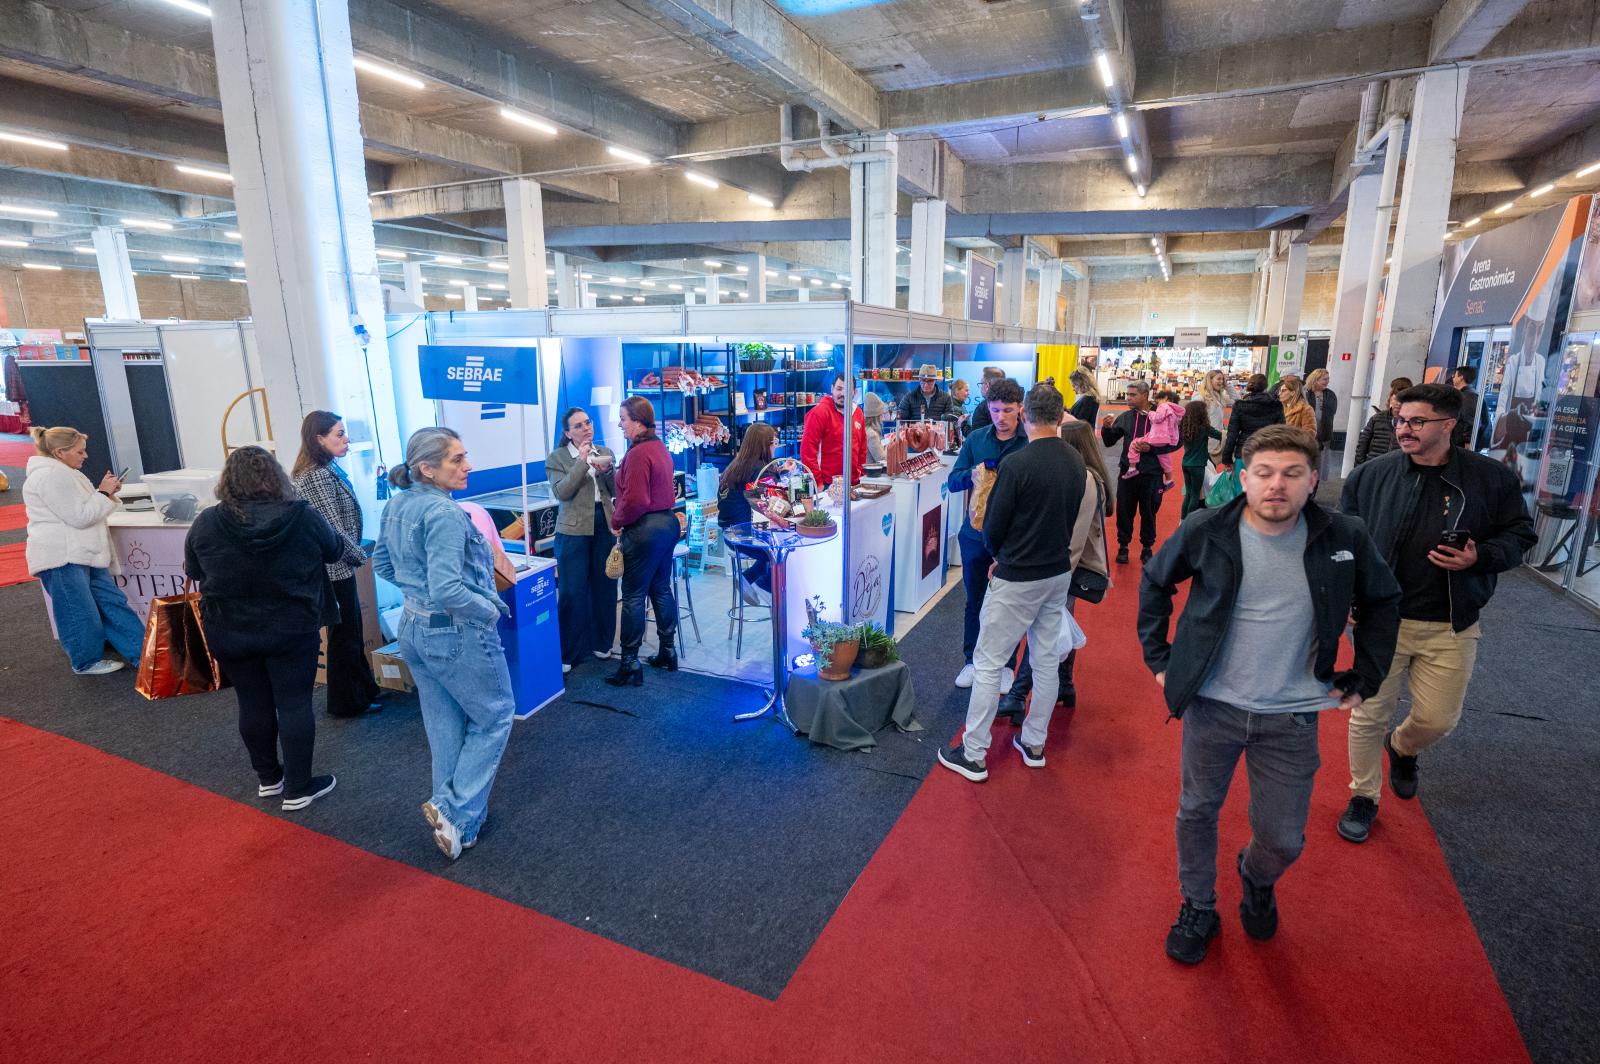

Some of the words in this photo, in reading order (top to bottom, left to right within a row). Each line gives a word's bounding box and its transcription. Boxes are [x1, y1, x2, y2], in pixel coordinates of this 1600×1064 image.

[1471, 259, 1491, 274] Arena
[1465, 299, 1487, 315] Senac
[447, 366, 503, 382] SEBRAE
[1562, 406, 1579, 415] ESSA
[530, 579, 550, 594] SEBRAE
